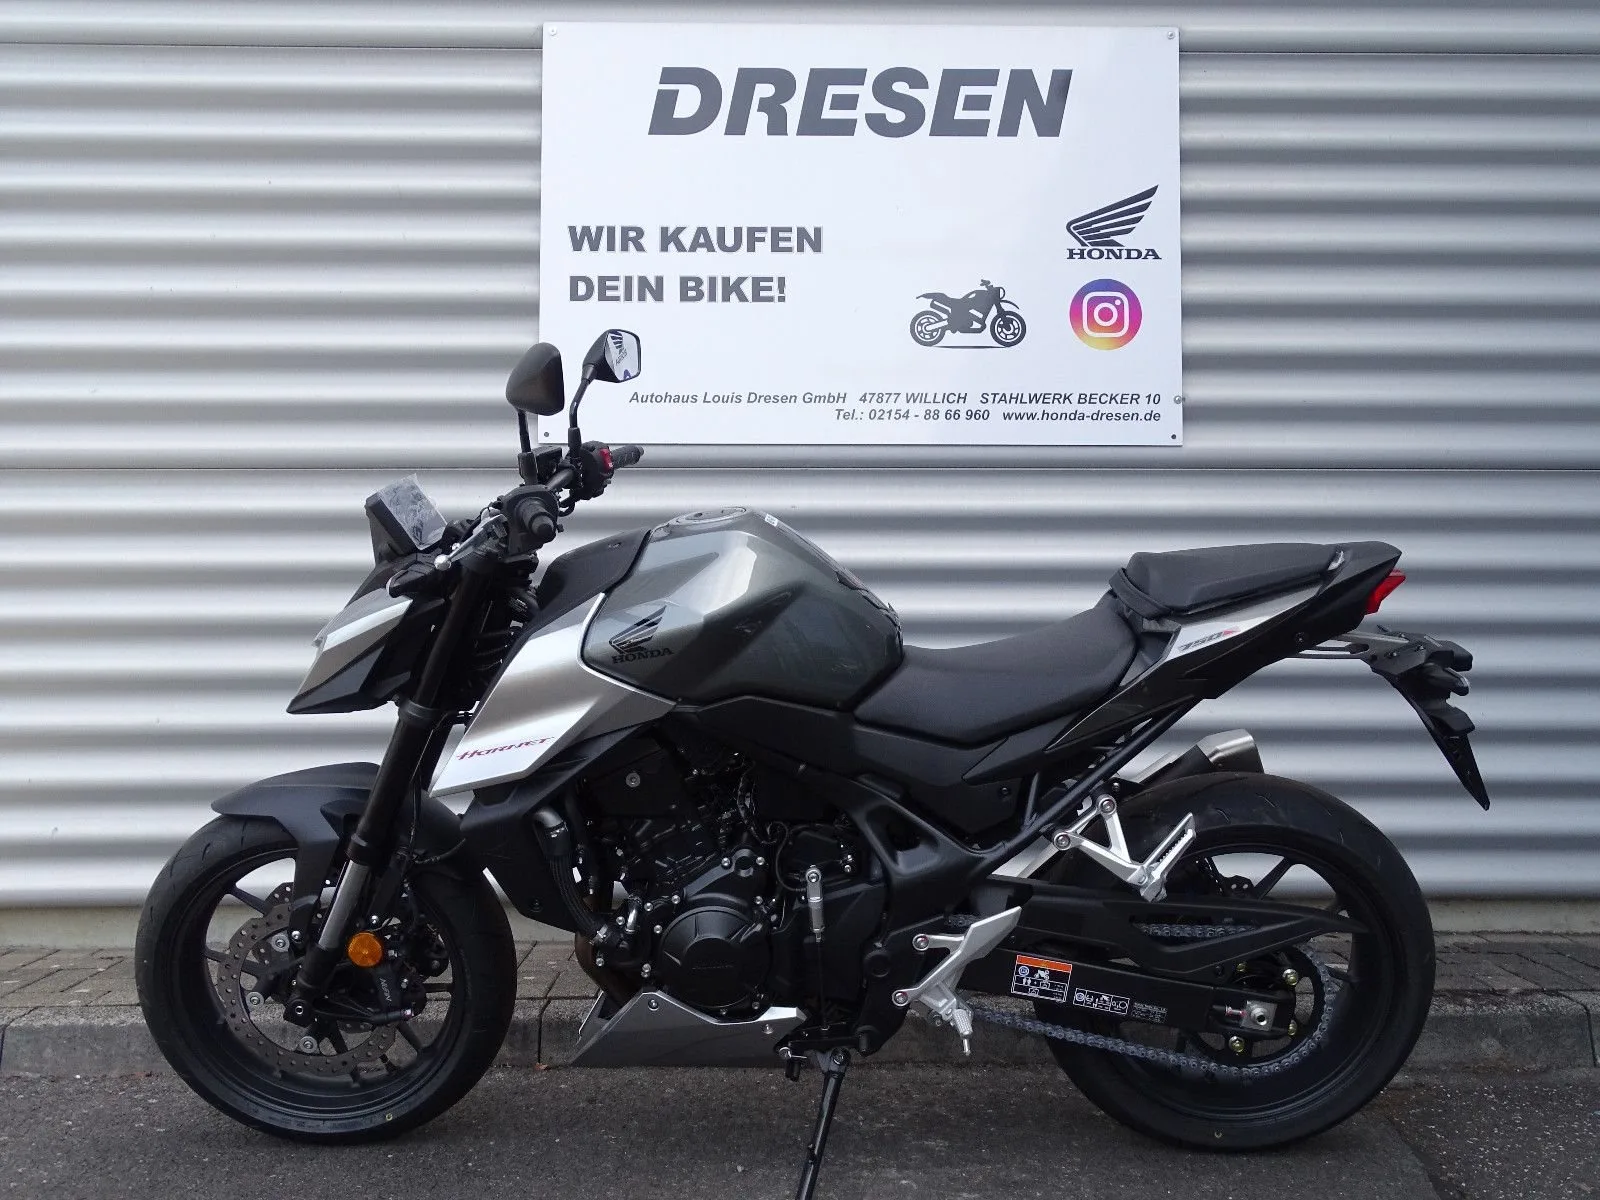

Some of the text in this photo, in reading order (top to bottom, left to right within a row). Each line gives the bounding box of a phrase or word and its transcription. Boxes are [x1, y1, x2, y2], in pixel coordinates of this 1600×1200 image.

[647, 66, 1074, 138] DRESEN
[567, 225, 823, 254] WIR KAUFEN
[1066, 247, 1163, 261] HONDA
[568, 275, 788, 304] DEIN BIKE!
[628, 391, 1162, 405] Autohaus Louis Dresen GmbH 47877 WILLICH STAHLWERK BECKER 10
[834, 408, 864, 421] Tel.:
[868, 408, 910, 421] 02154
[923, 408, 941, 421] 88
[944, 408, 961, 421] 66
[964, 408, 991, 421] 960
[1002, 409, 1162, 422] www.honda-dresen.de
[612, 647, 673, 664] HONDA
